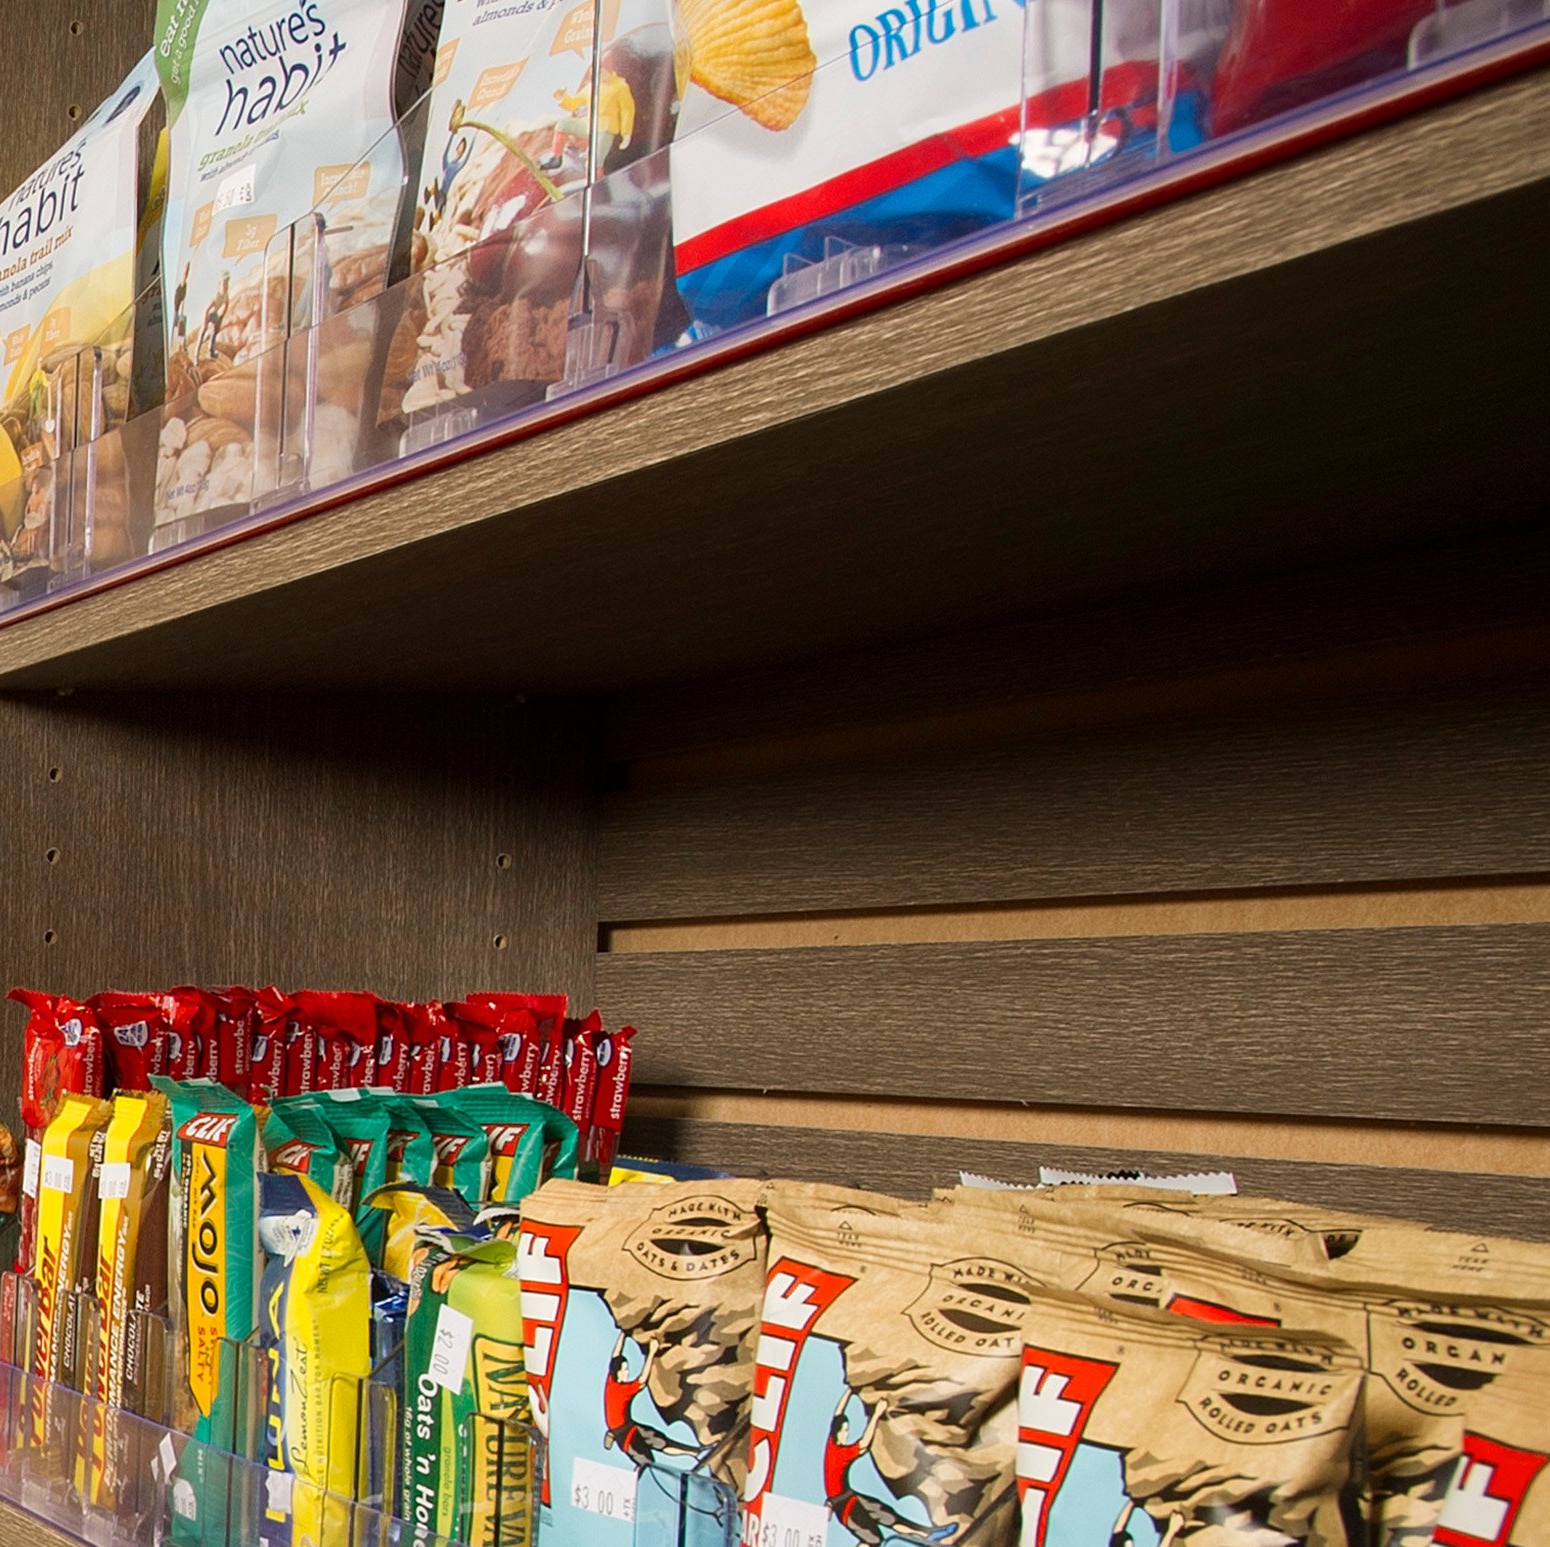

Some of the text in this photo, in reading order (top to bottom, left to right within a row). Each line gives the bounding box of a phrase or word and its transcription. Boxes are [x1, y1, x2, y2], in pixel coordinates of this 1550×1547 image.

[215, 31, 347, 137] habit
[573, 1046, 594, 1121] strawberry
[610, 1046, 632, 1120] strawberry
[185, 1116, 234, 1143] CLIF
[635, 1242, 740, 1273] OATS DATES
[953, 1265, 995, 1279] MADE
[942, 1295, 1026, 1320] ORGANI
[920, 1311, 1015, 1351] ROLLED OAT
[1401, 1335, 1507, 1366] ORGAN
[746, 1272, 820, 1502] CLIF
[1217, 1369, 1333, 1396] ORGANIC
[1396, 1366, 1458, 1409] ROLLED
[1200, 1396, 1323, 1436] ROLLED OATS
